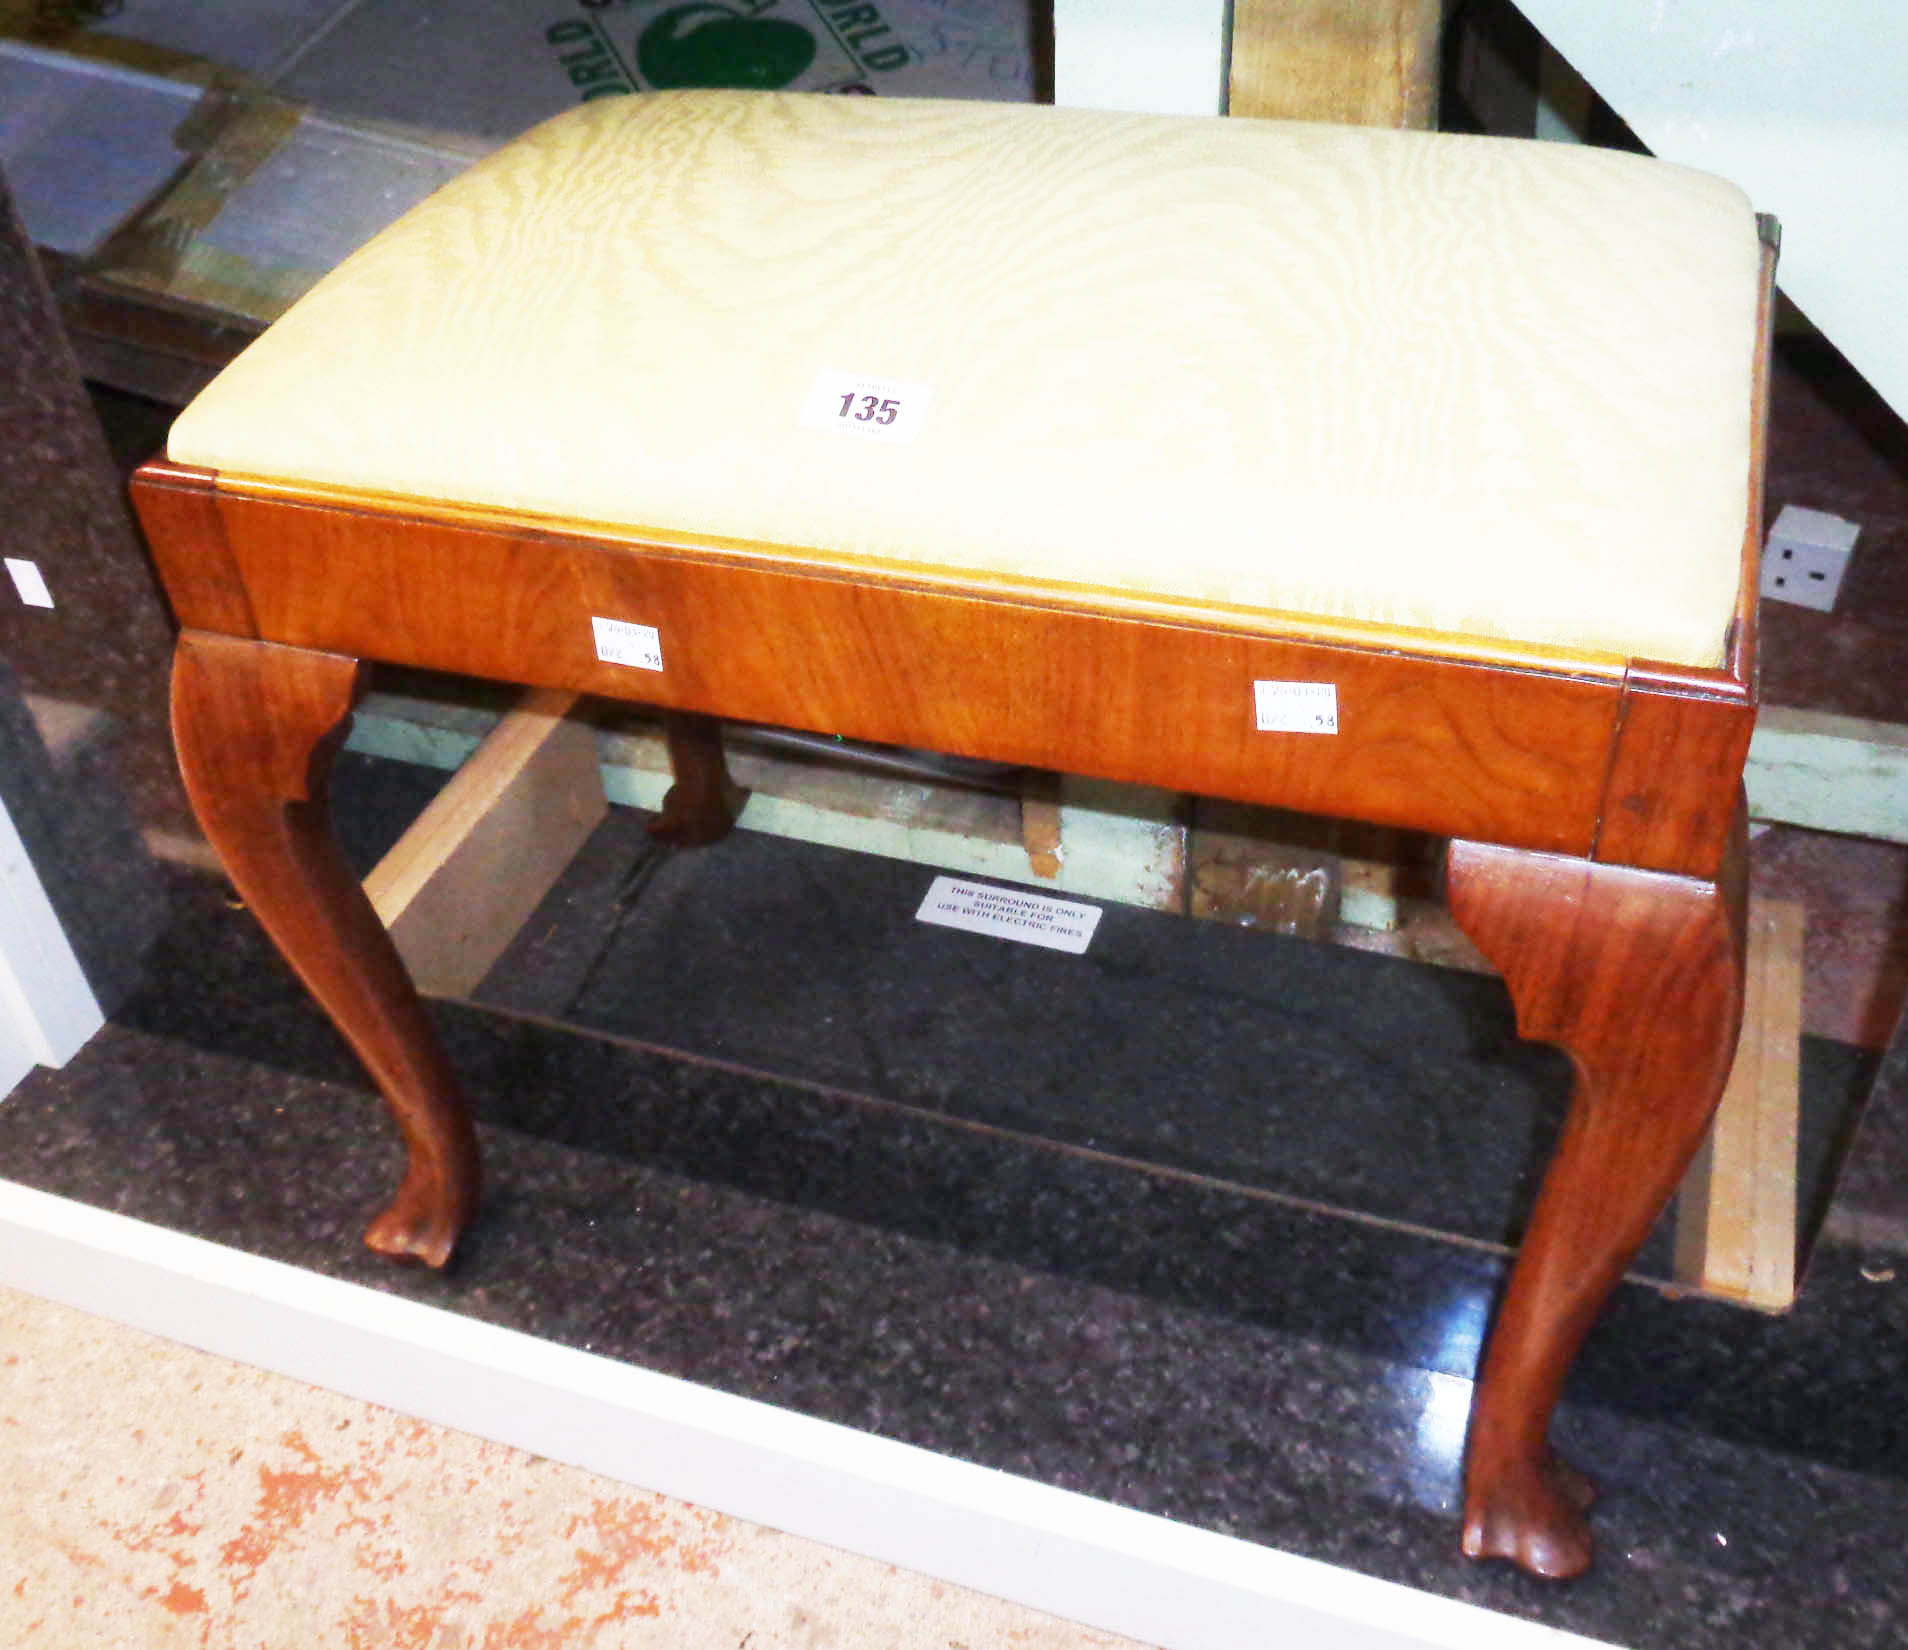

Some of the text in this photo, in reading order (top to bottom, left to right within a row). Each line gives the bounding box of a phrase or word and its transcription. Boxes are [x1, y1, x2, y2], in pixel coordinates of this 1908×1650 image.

[816, 0, 909, 71] RLD
[839, 392, 900, 425] 135
[951, 887, 1086, 919] THIS SURROUND IS ONLY
[974, 901, 1054, 921] SUITABLE FOR
[937, 903, 1082, 937] USE WITH ELECTRIC FIRES
